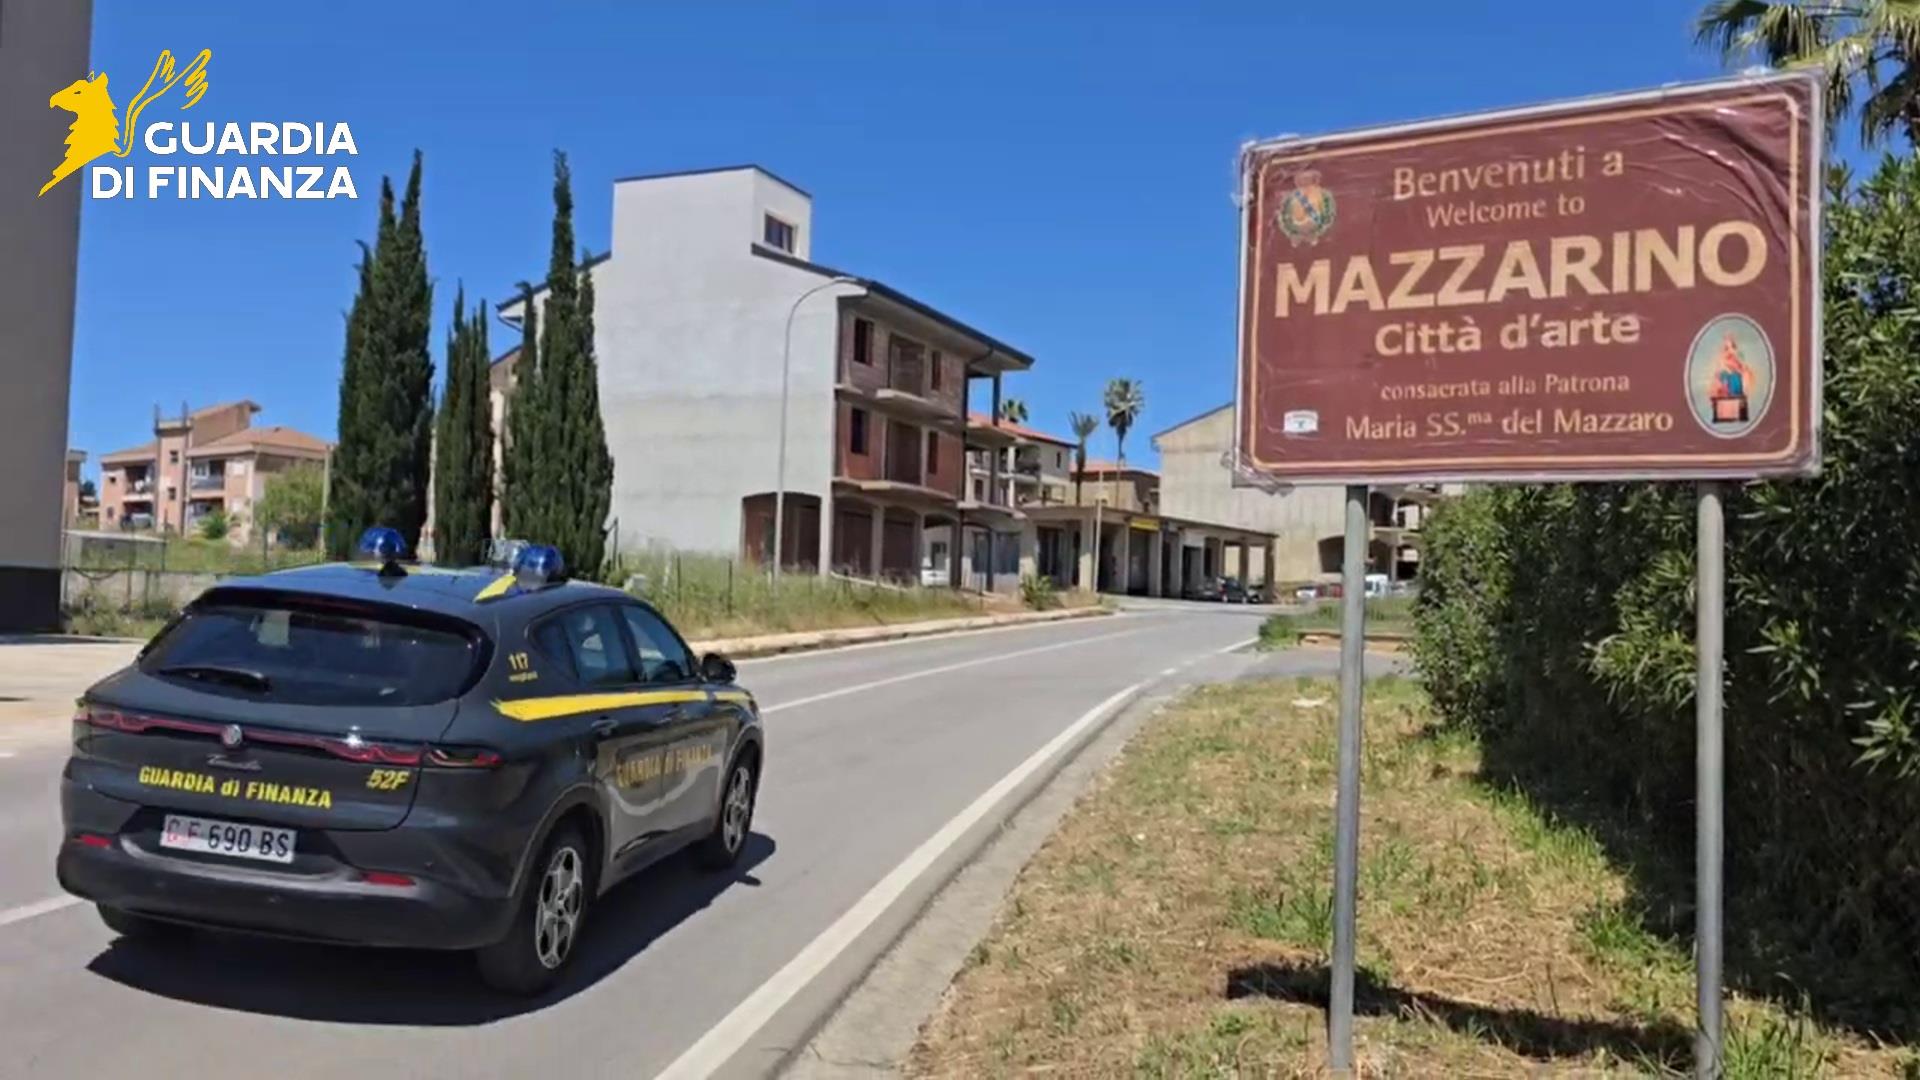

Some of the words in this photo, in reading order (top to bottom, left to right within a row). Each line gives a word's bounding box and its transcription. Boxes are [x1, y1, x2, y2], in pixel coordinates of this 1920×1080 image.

[1393, 146, 1585, 201] Benvenuti
[1602, 150, 1625, 177] a
[1426, 198, 1547, 229] Welcome
[1557, 193, 1585, 216] to
[1274, 220, 1768, 318] MAZZARINO
[1374, 315, 1484, 356] Città
[1500, 312, 1641, 350] d'arte
[1380, 378, 1491, 401] consacrata
[1498, 375, 1537, 397] alla
[1544, 373, 1630, 394] Patrona
[1345, 413, 1417, 440] Maria
[1501, 408, 1543, 435] del
[1553, 408, 1674, 434] Mazzaro
[508, 652, 529, 670] 117
[138, 766, 215, 794] GUARDIA
[245, 781, 332, 809] FINANZA
[365, 769, 409, 790] 52F
[207, 824, 252, 853] 690
[259, 830, 290, 857] BS
